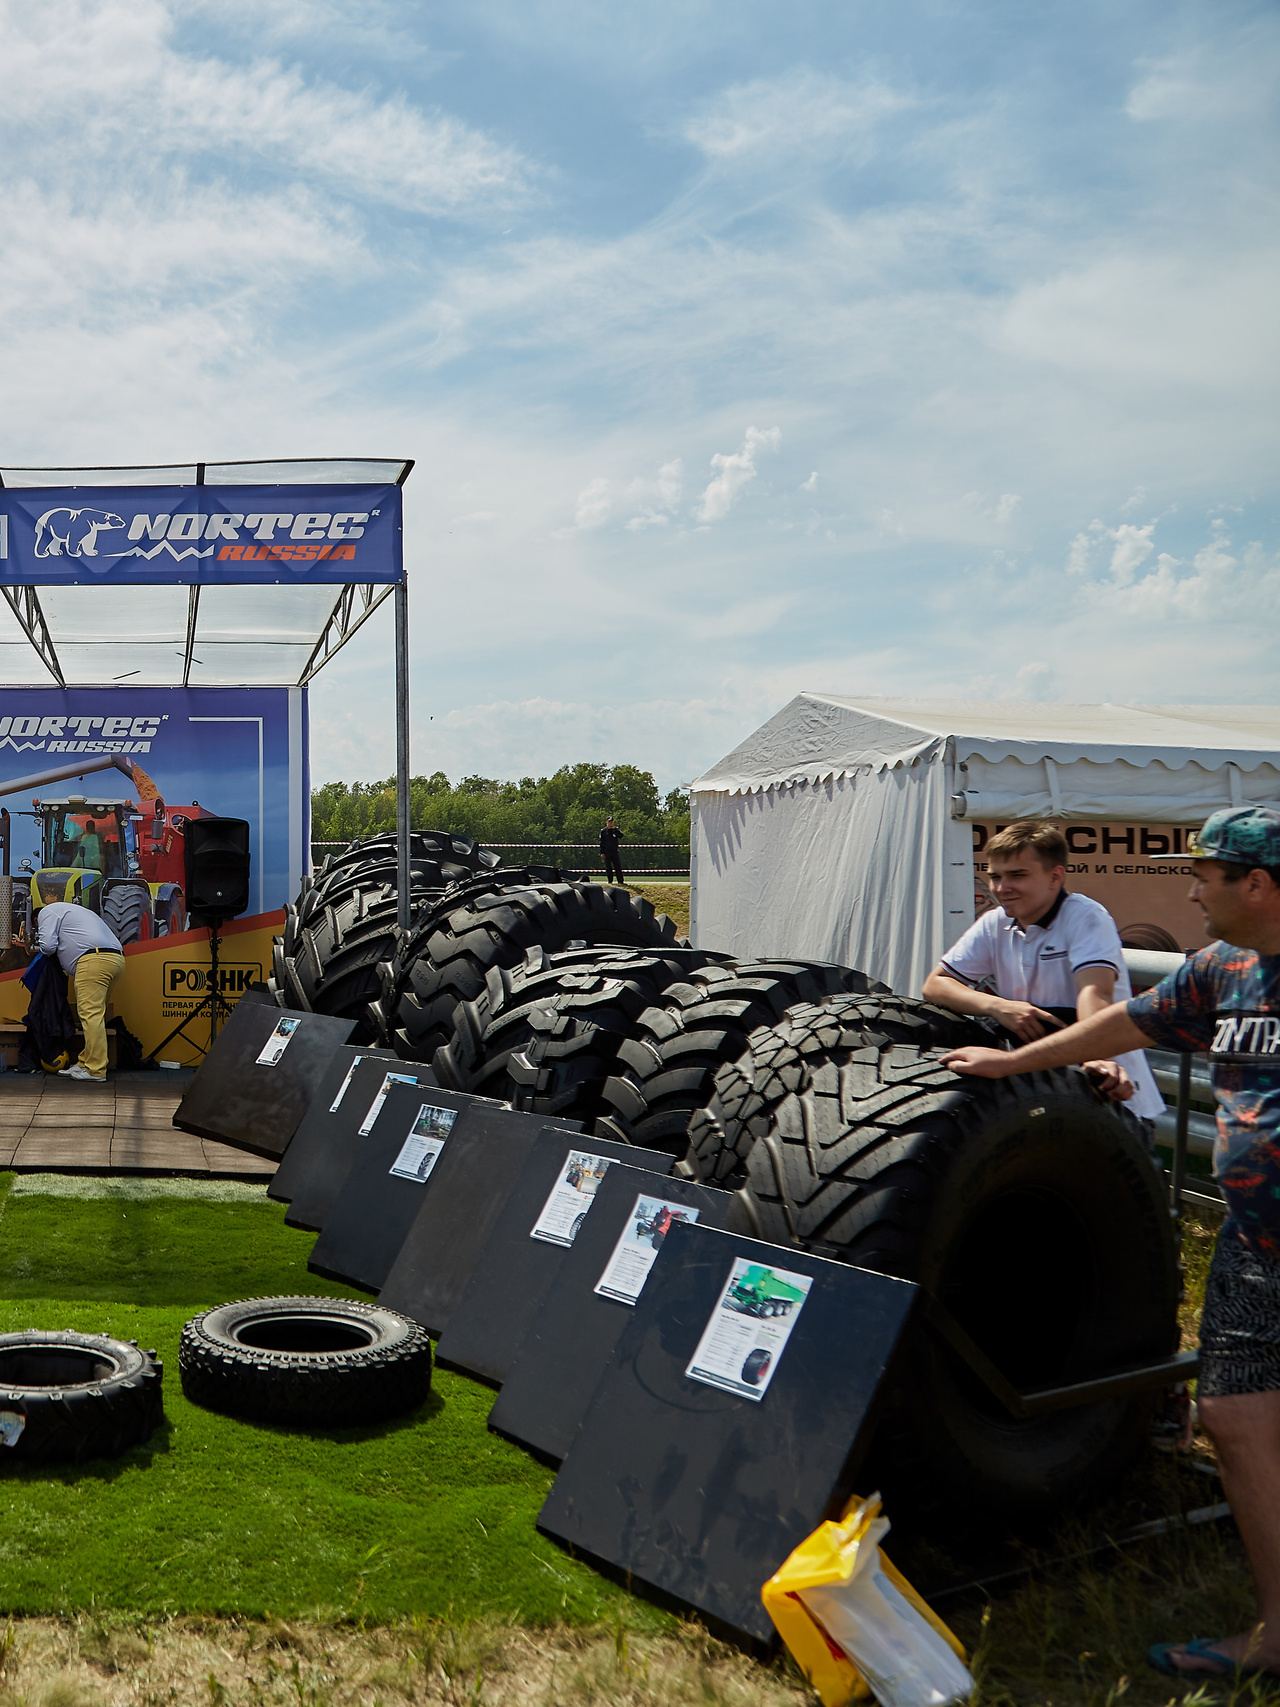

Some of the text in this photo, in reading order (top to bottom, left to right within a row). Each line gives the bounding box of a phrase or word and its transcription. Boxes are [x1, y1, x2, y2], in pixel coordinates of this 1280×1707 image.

[127, 513, 369, 540] NORTEC
[216, 545, 357, 561] RUSSIA
[46, 741, 151, 753] RUSSIA
[1114, 865, 1192, 875] СЕЛЬСКО
